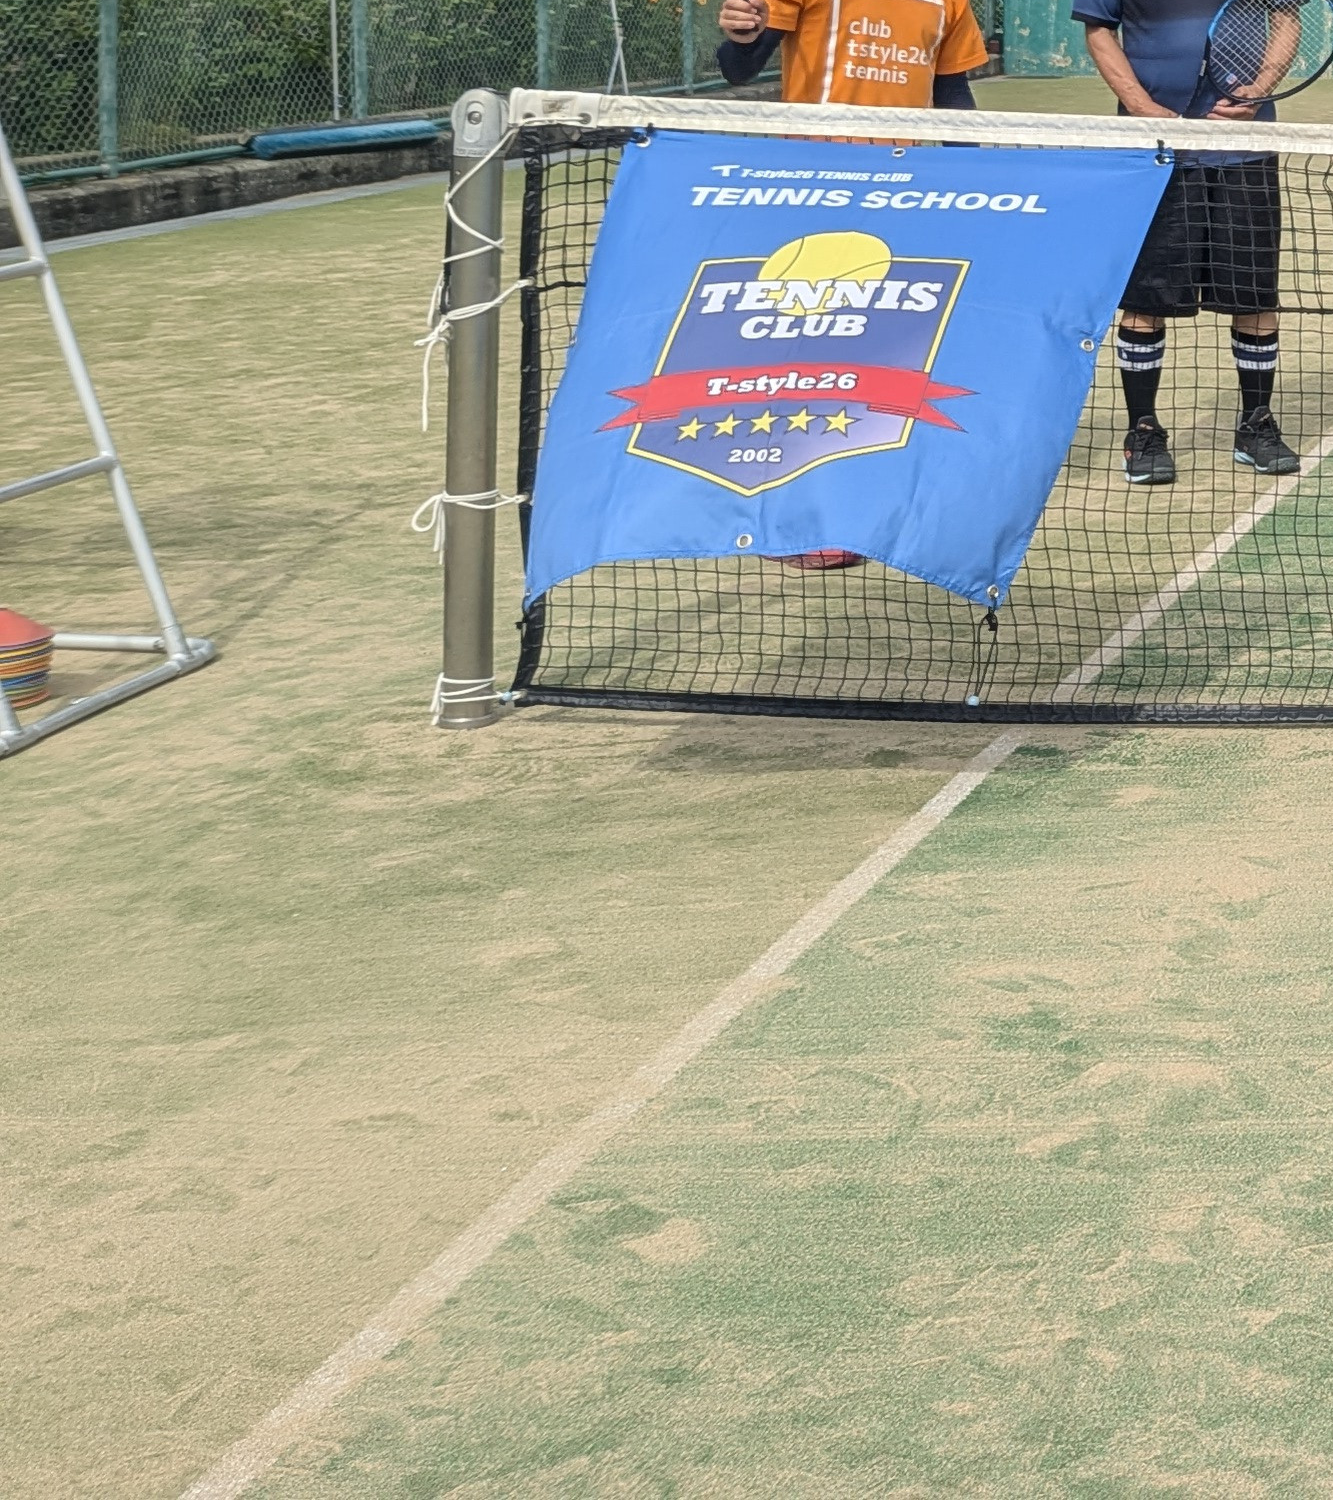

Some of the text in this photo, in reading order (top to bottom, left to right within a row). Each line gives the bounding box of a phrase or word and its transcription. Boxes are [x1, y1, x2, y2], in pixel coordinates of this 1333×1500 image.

[849, 16, 892, 39] club
[844, 60, 909, 84] tennis
[741, 168, 814, 180] T-style26
[816, 170, 872, 182] TENNIS
[873, 172, 914, 183] CLUB
[690, 186, 1049, 214] TENNIS SCHOOL
[700, 280, 943, 314] TENNIS
[740, 314, 868, 339] CLUB
[706, 372, 858, 396] T-style26
[727, 448, 783, 463] 2002
